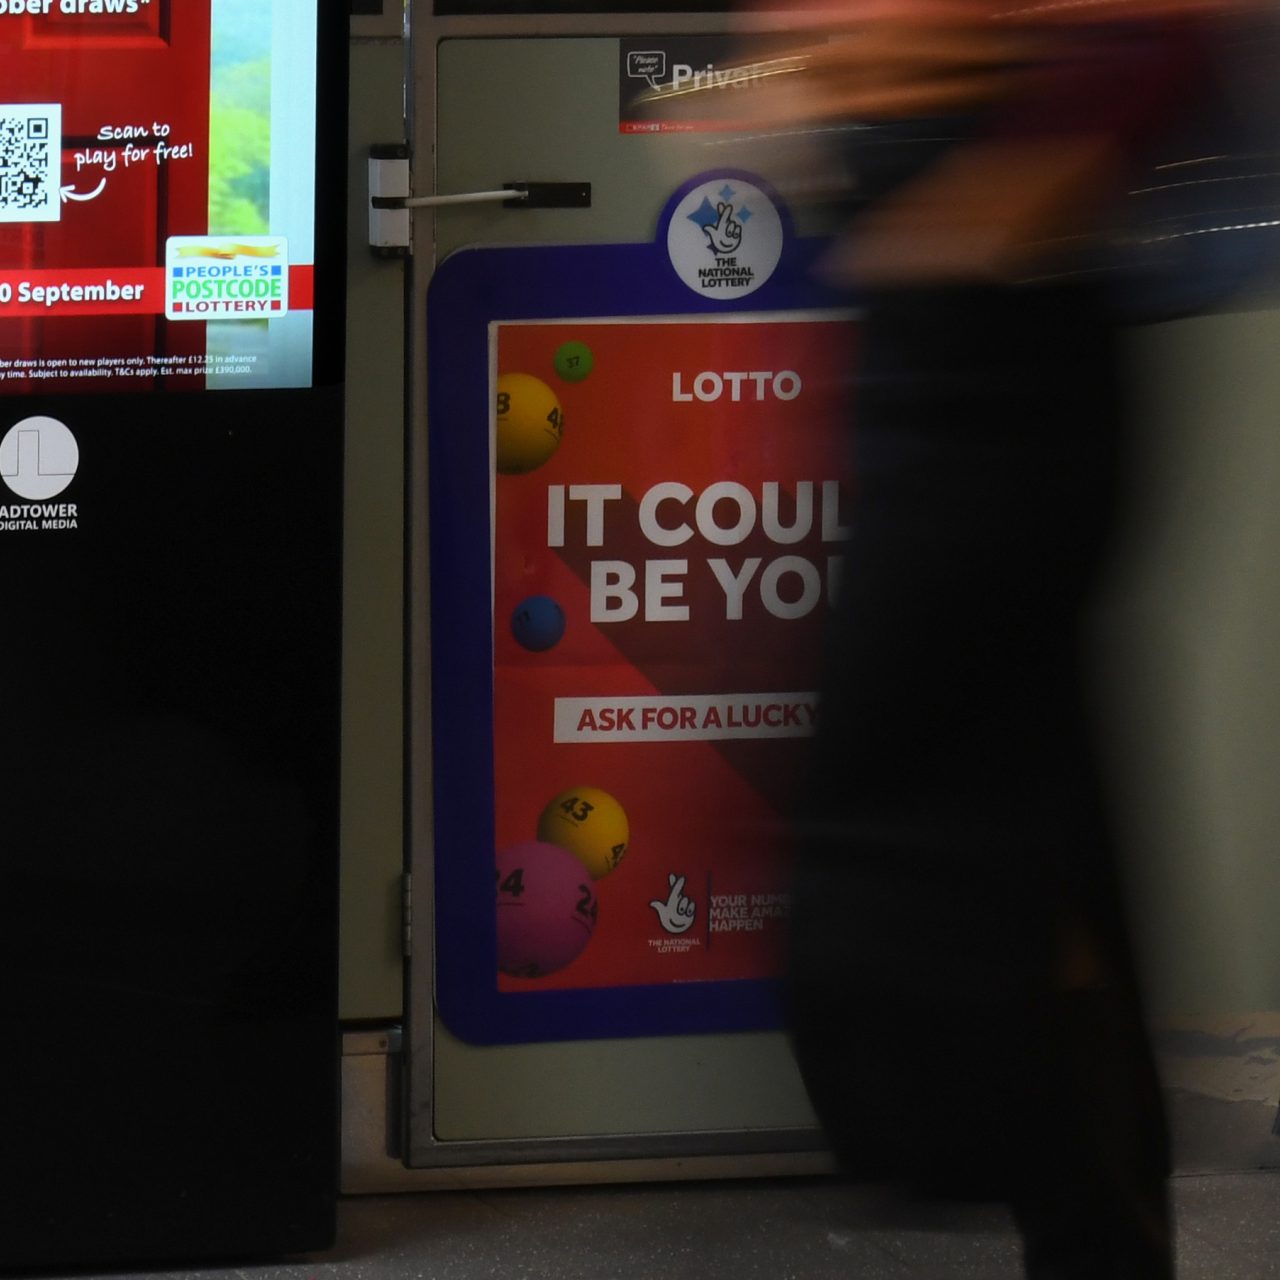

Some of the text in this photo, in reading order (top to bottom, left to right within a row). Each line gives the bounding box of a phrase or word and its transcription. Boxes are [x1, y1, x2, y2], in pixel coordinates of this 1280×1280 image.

[672, 64, 763, 91] Privat
[97, 121, 170, 140] Scan to
[74, 141, 193, 172] play for free!
[715, 257, 737, 267] THE
[186, 265, 269, 277] PEOPLE'S
[698, 267, 754, 278] NATIONAL
[172, 279, 281, 299] POSTCODE
[702, 277, 751, 288] LOTTERY
[18, 280, 144, 307] September
[186, 300, 268, 312] LOTTERY
[13, 359, 37, 368] draws
[39, 359, 45, 368] is
[46, 359, 67, 369] open
[68, 358, 77, 367] to
[79, 358, 95, 366] new
[97, 357, 125, 367] players
[127, 356, 145, 366] only.
[146, 355, 187, 365] Thereafter
[215, 355, 223, 363] in
[224, 355, 257, 363] advance
[7, 370, 27, 378] time.
[29, 369, 58, 379] Subject
[60, 369, 68, 377] to
[70, 367, 113, 377] availability.
[115, 366, 134, 376] T&Cs
[135, 366, 159, 377] apply.
[160, 366, 175, 375] Est.
[176, 367, 192, 375] max
[194, 365, 214, 376] prize
[672, 370, 802, 402] LOTTO
[547, 480, 858, 548] IT COUL
[41, 518, 78, 530] MEDIA
[590, 558, 690, 623] BE
[577, 707, 636, 732] ASK
[641, 706, 698, 730] FOR
[702, 705, 722, 729] A
[560, 797, 595, 822] 43
[710, 895, 747, 908] YOUR
[709, 907, 748, 919] MAKE
[709, 919, 763, 932] HAPPEN
[664, 937, 701, 946] NATIONAL
